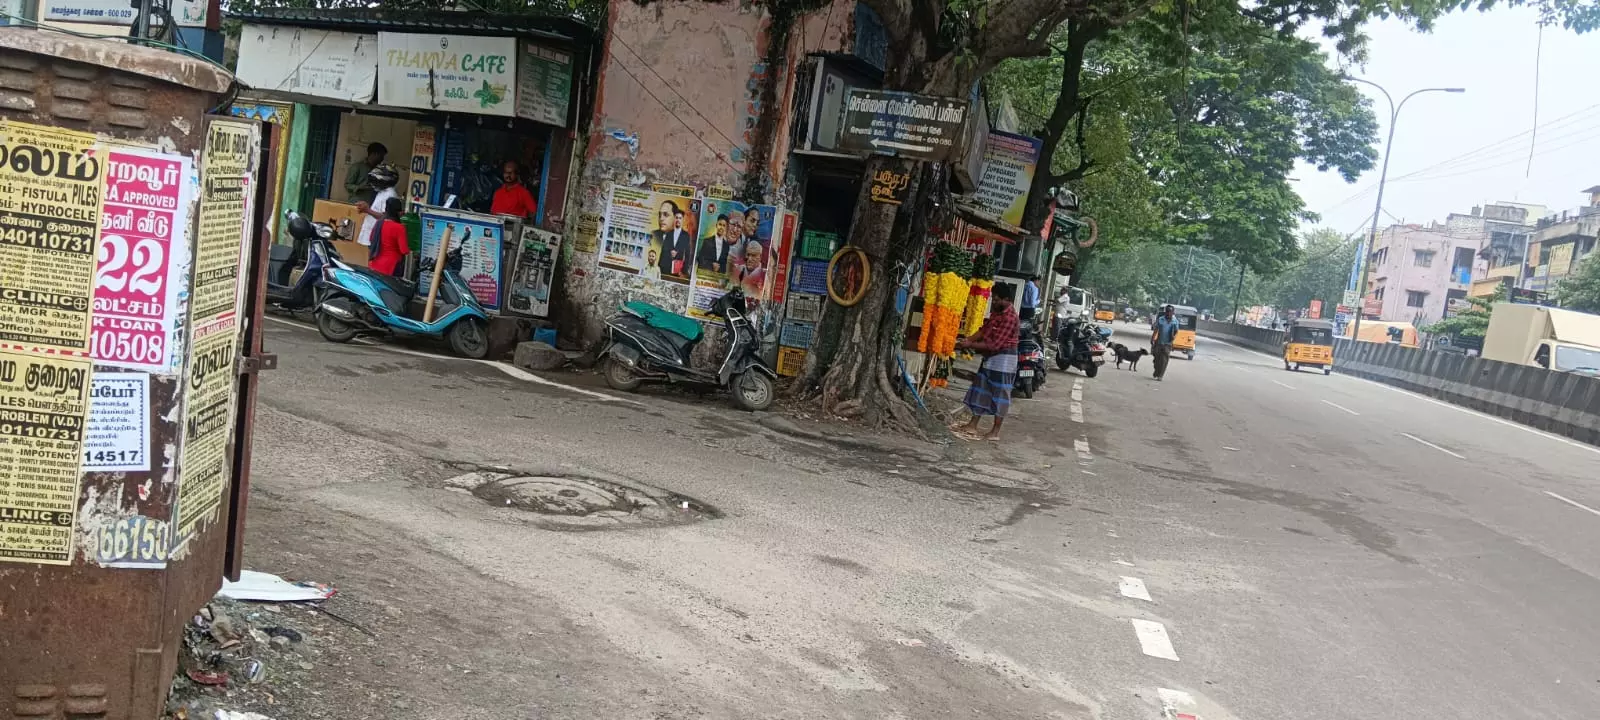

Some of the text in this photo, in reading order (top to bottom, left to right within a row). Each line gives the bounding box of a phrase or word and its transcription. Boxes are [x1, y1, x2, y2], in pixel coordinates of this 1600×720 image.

[461, 53, 507, 74] CAFE
[849, 94, 966, 123] சென்னை மேல்நிலைப் பள்ளி
[0, 144, 98, 181] லம்
[22, 187, 67, 203] FISTULA
[72, 183, 97, 207] PILES
[123, 191, 176, 208] APPROVED
[21, 201, 95, 221] HYDROCELE
[101, 209, 168, 238] தனி வீடு
[33, 248, 90, 260] IMPOTENCY
[96, 234, 164, 296] 22
[2, 290, 73, 306] CLINIC
[93, 297, 162, 316] லட்சம்
[19, 307, 47, 317] MGR
[111, 319, 156, 332] LOAN
[192, 340, 232, 390] மூலம்
[25, 363, 86, 400] குறைவு
[0, 410, 50, 424] ROBLEM
[52, 416, 81, 430] (V.D.)
[0, 424, 79, 440] 0110731
[84, 450, 138, 462] 14517
[1, 508, 53, 521] LINIC
[14, 500, 72, 510] URINE PROBLEMS
